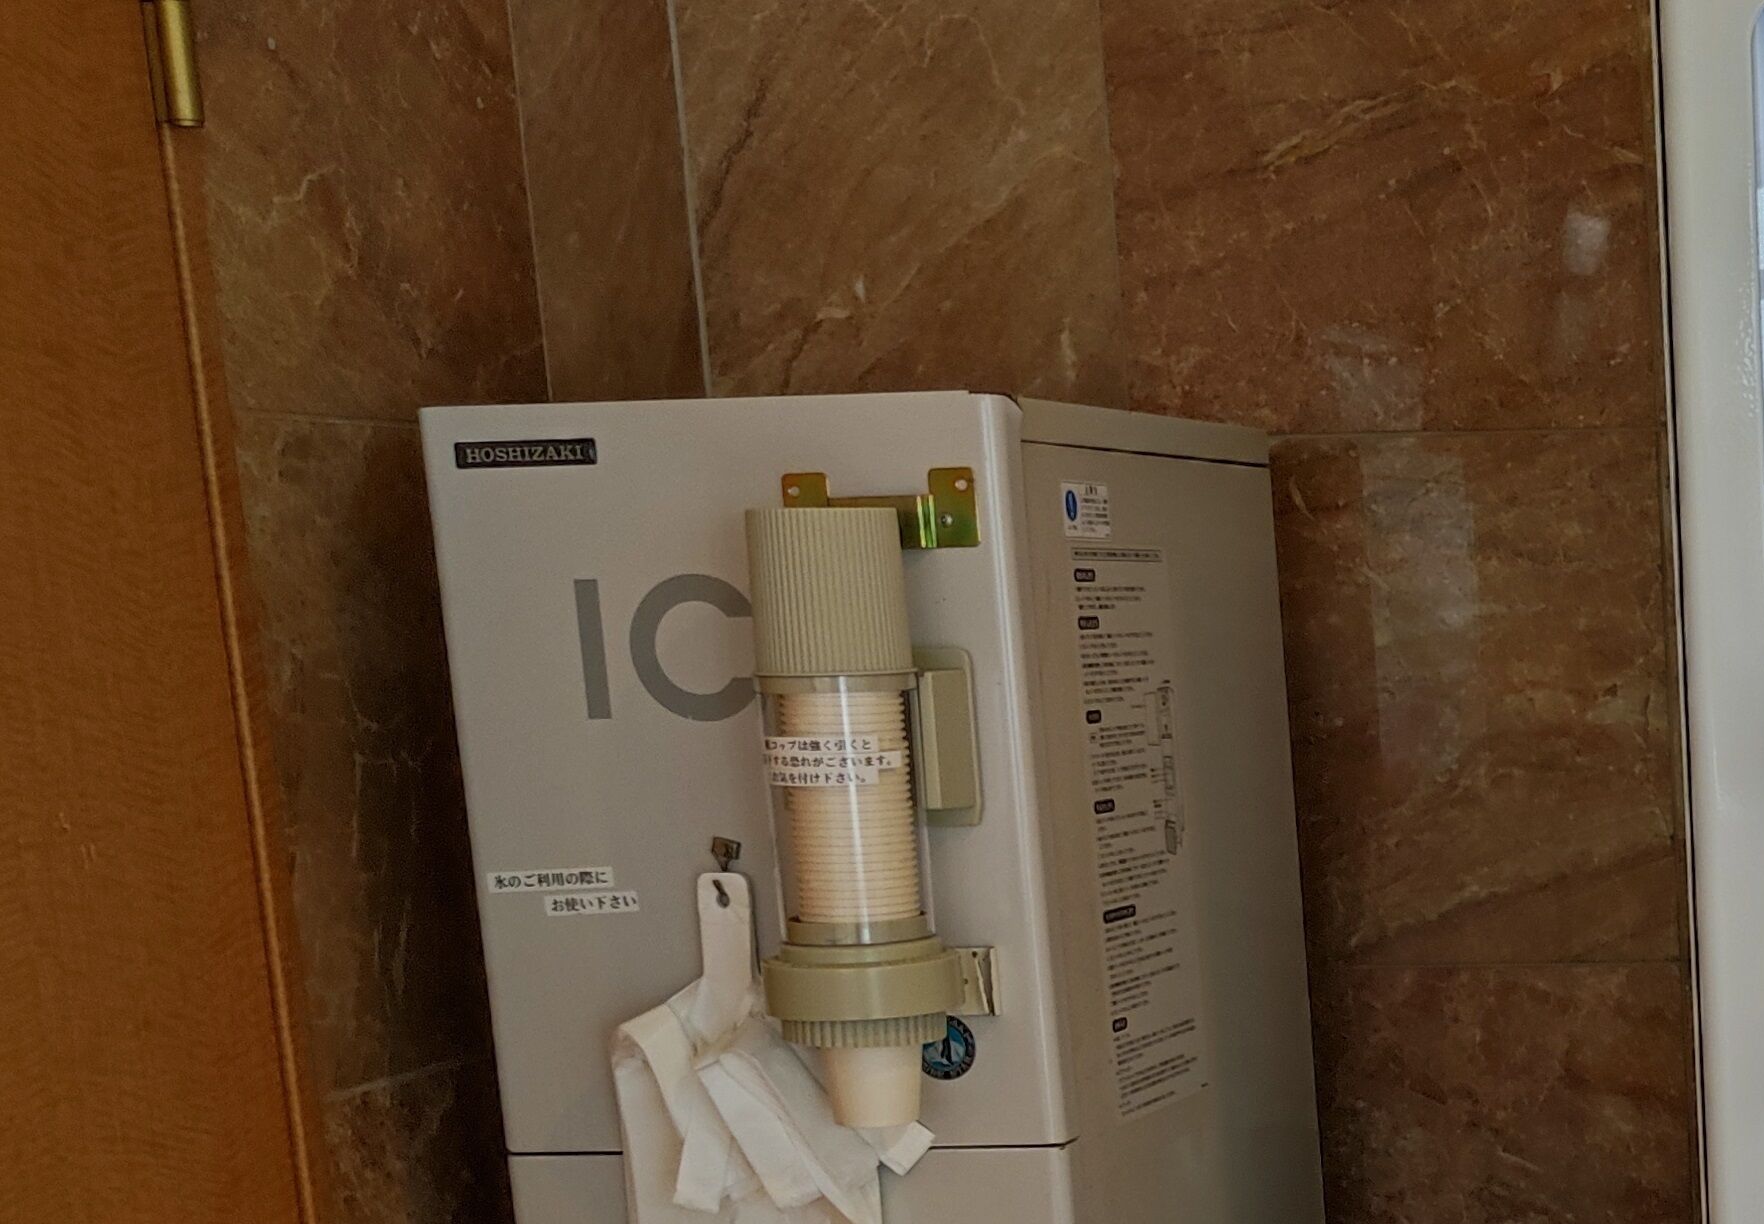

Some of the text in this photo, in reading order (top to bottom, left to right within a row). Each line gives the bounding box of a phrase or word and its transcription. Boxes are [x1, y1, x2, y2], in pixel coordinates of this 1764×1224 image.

[465, 442, 584, 466] HOSHIZAKI
[573, 572, 762, 723] IC
[493, 870, 609, 890] 氷のご利用の際に
[550, 894, 638, 913] お使い下さい
